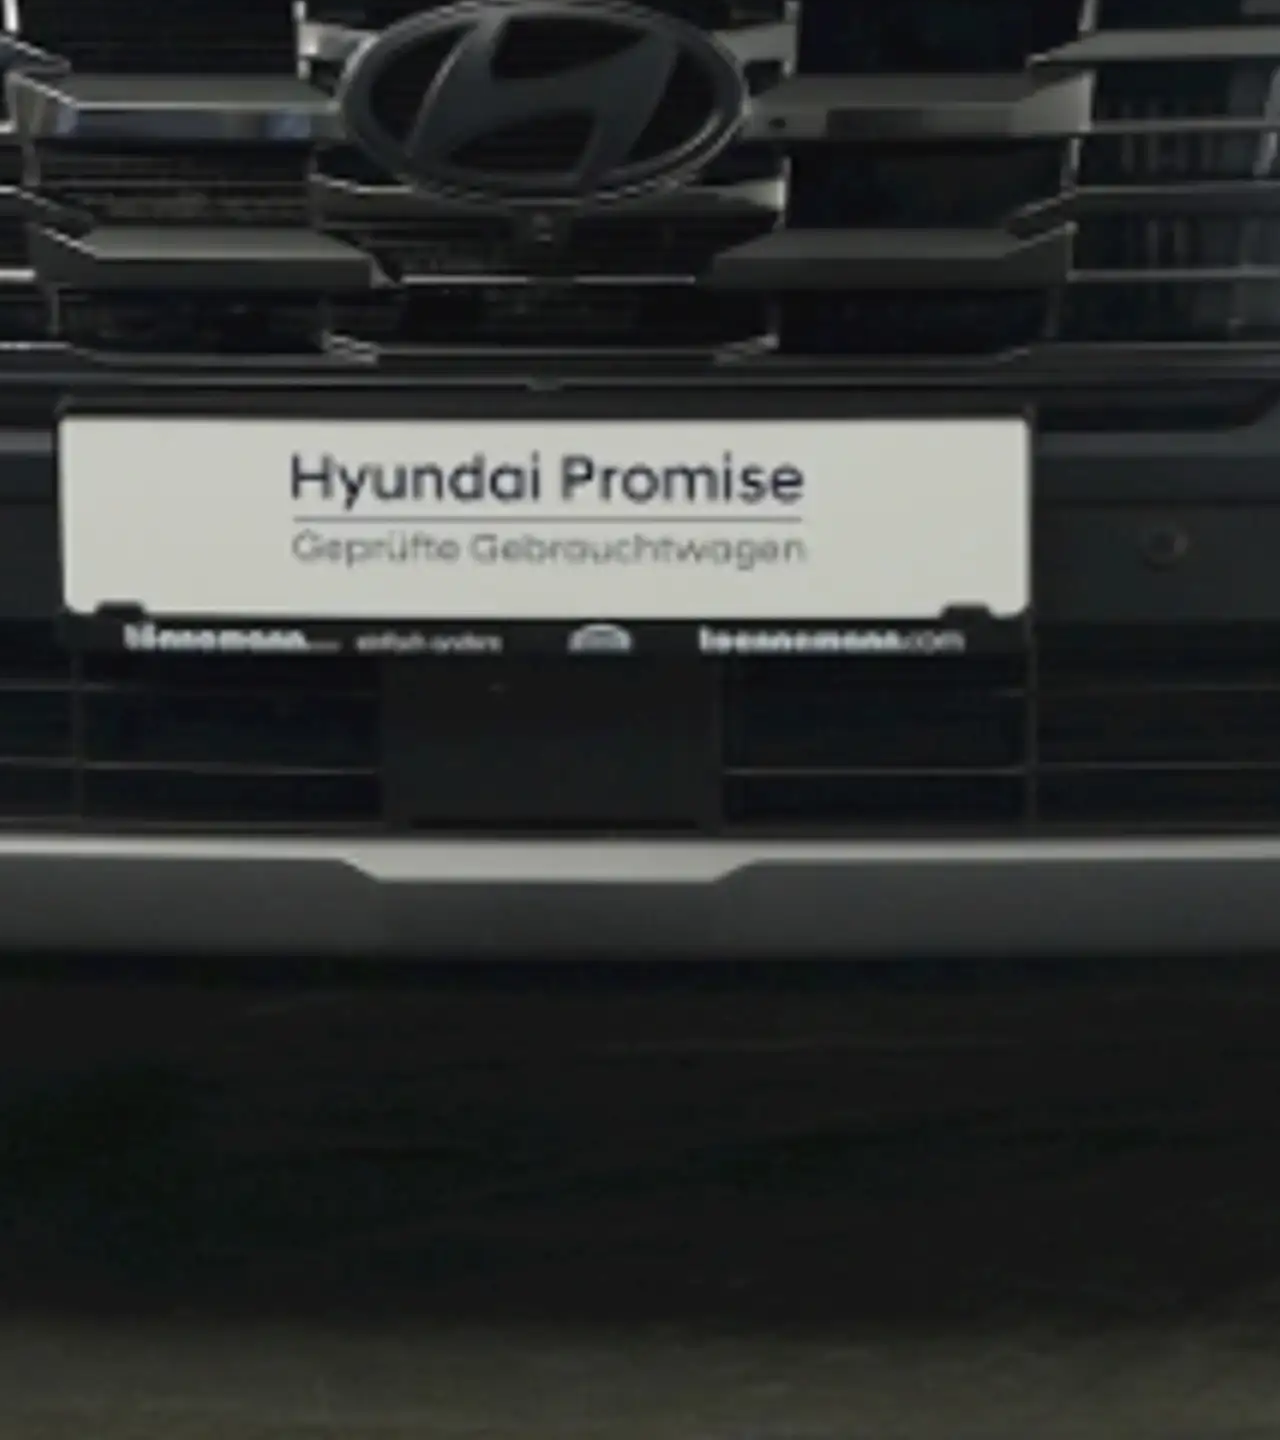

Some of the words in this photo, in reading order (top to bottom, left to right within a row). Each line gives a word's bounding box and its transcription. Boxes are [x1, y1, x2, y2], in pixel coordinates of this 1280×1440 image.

[290, 451, 540, 511] Hyundai
[561, 451, 805, 504] Promise
[291, 527, 460, 570] Geprüfte
[469, 528, 806, 572] Gebrauchtwagen
